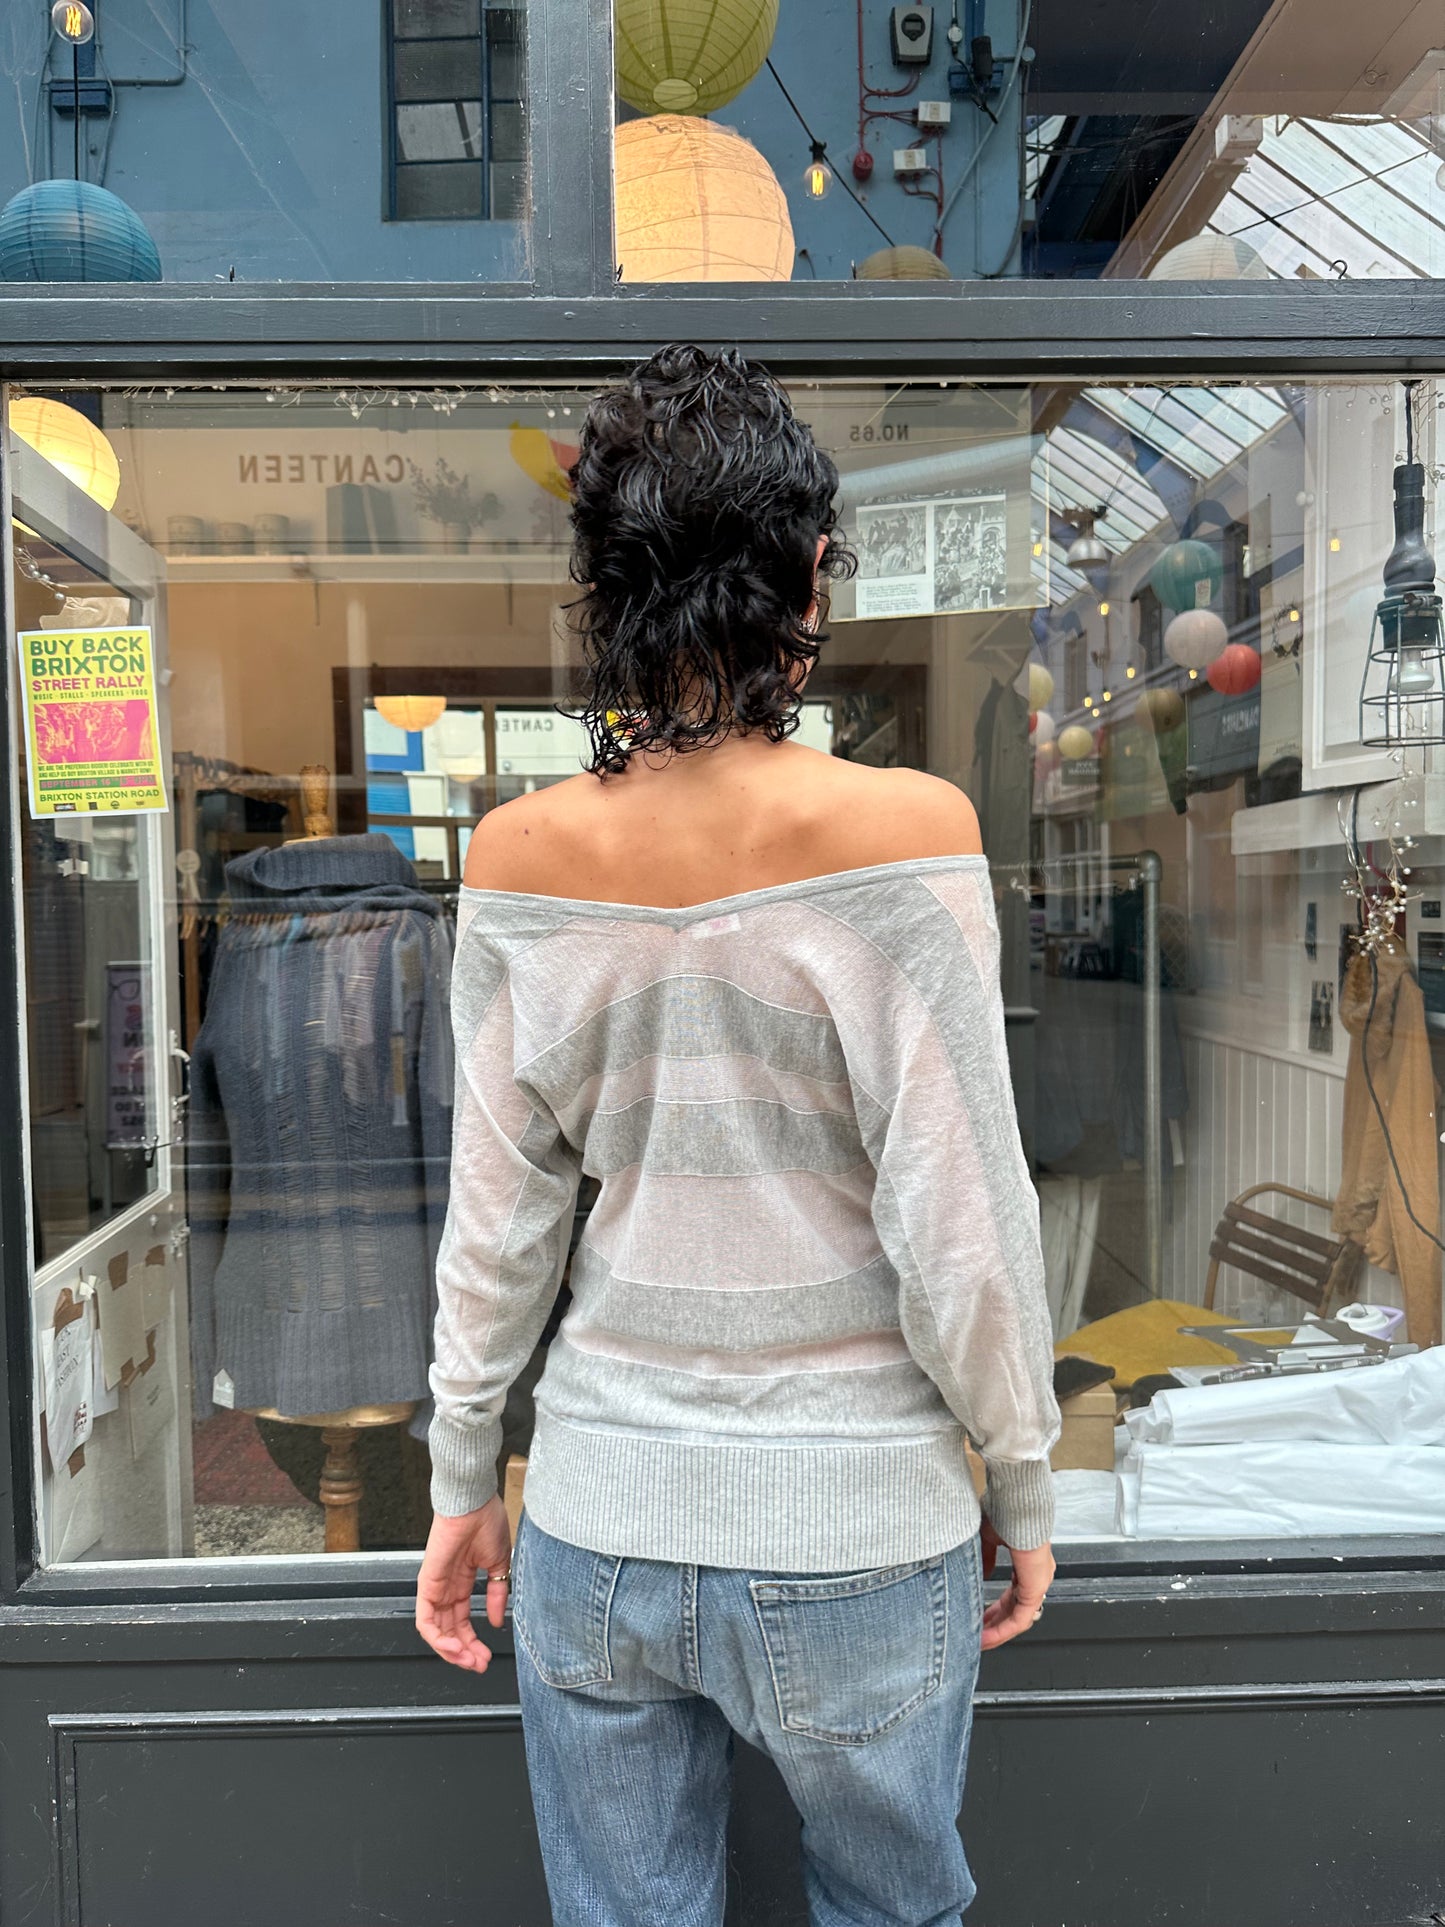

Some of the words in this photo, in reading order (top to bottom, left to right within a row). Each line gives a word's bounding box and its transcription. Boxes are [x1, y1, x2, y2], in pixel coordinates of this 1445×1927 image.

[30, 639, 74, 656] BUY
[82, 636, 143, 653] BACK
[32, 654, 145, 677] BRIXTON
[32, 677, 91, 692] STREET
[95, 675, 145, 689] RALLY
[60, 691, 84, 699] STALLS
[91, 690, 124, 698] SPEAKERS
[41, 779, 97, 788] SEPTEMBER
[40, 793, 83, 802] BRIXTON
[86, 791, 128, 800] STATION
[130, 789, 160, 798] ROAD
